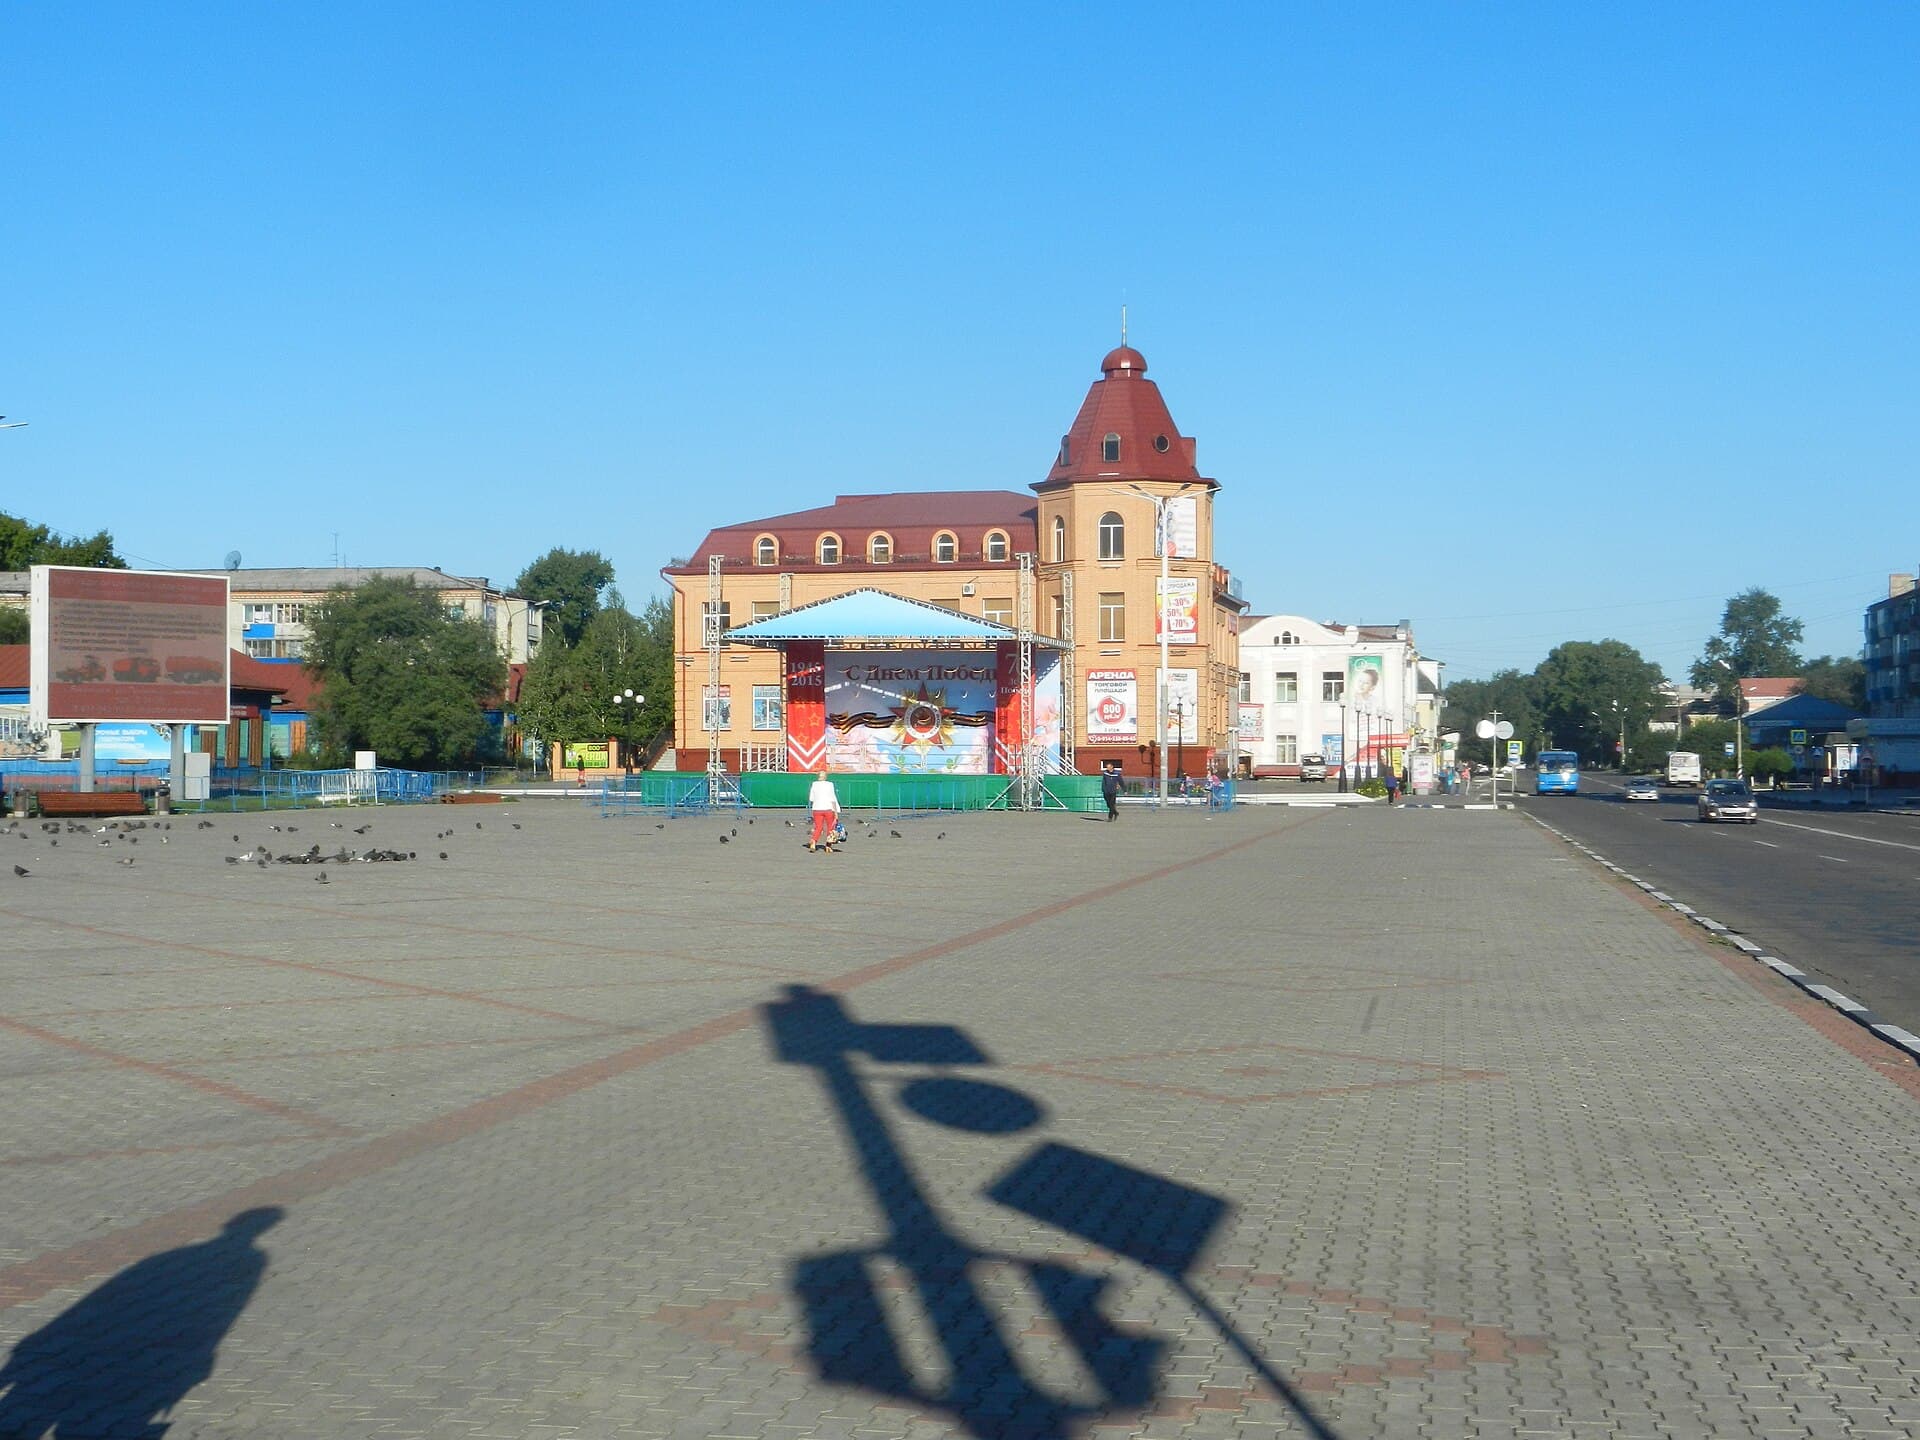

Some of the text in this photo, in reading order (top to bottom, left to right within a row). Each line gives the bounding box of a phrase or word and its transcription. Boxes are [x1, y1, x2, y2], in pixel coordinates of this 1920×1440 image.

[846, 664, 859, 680] С
[1088, 671, 1135, 680] АРЕНДА
[791, 675, 822, 686] 2015
